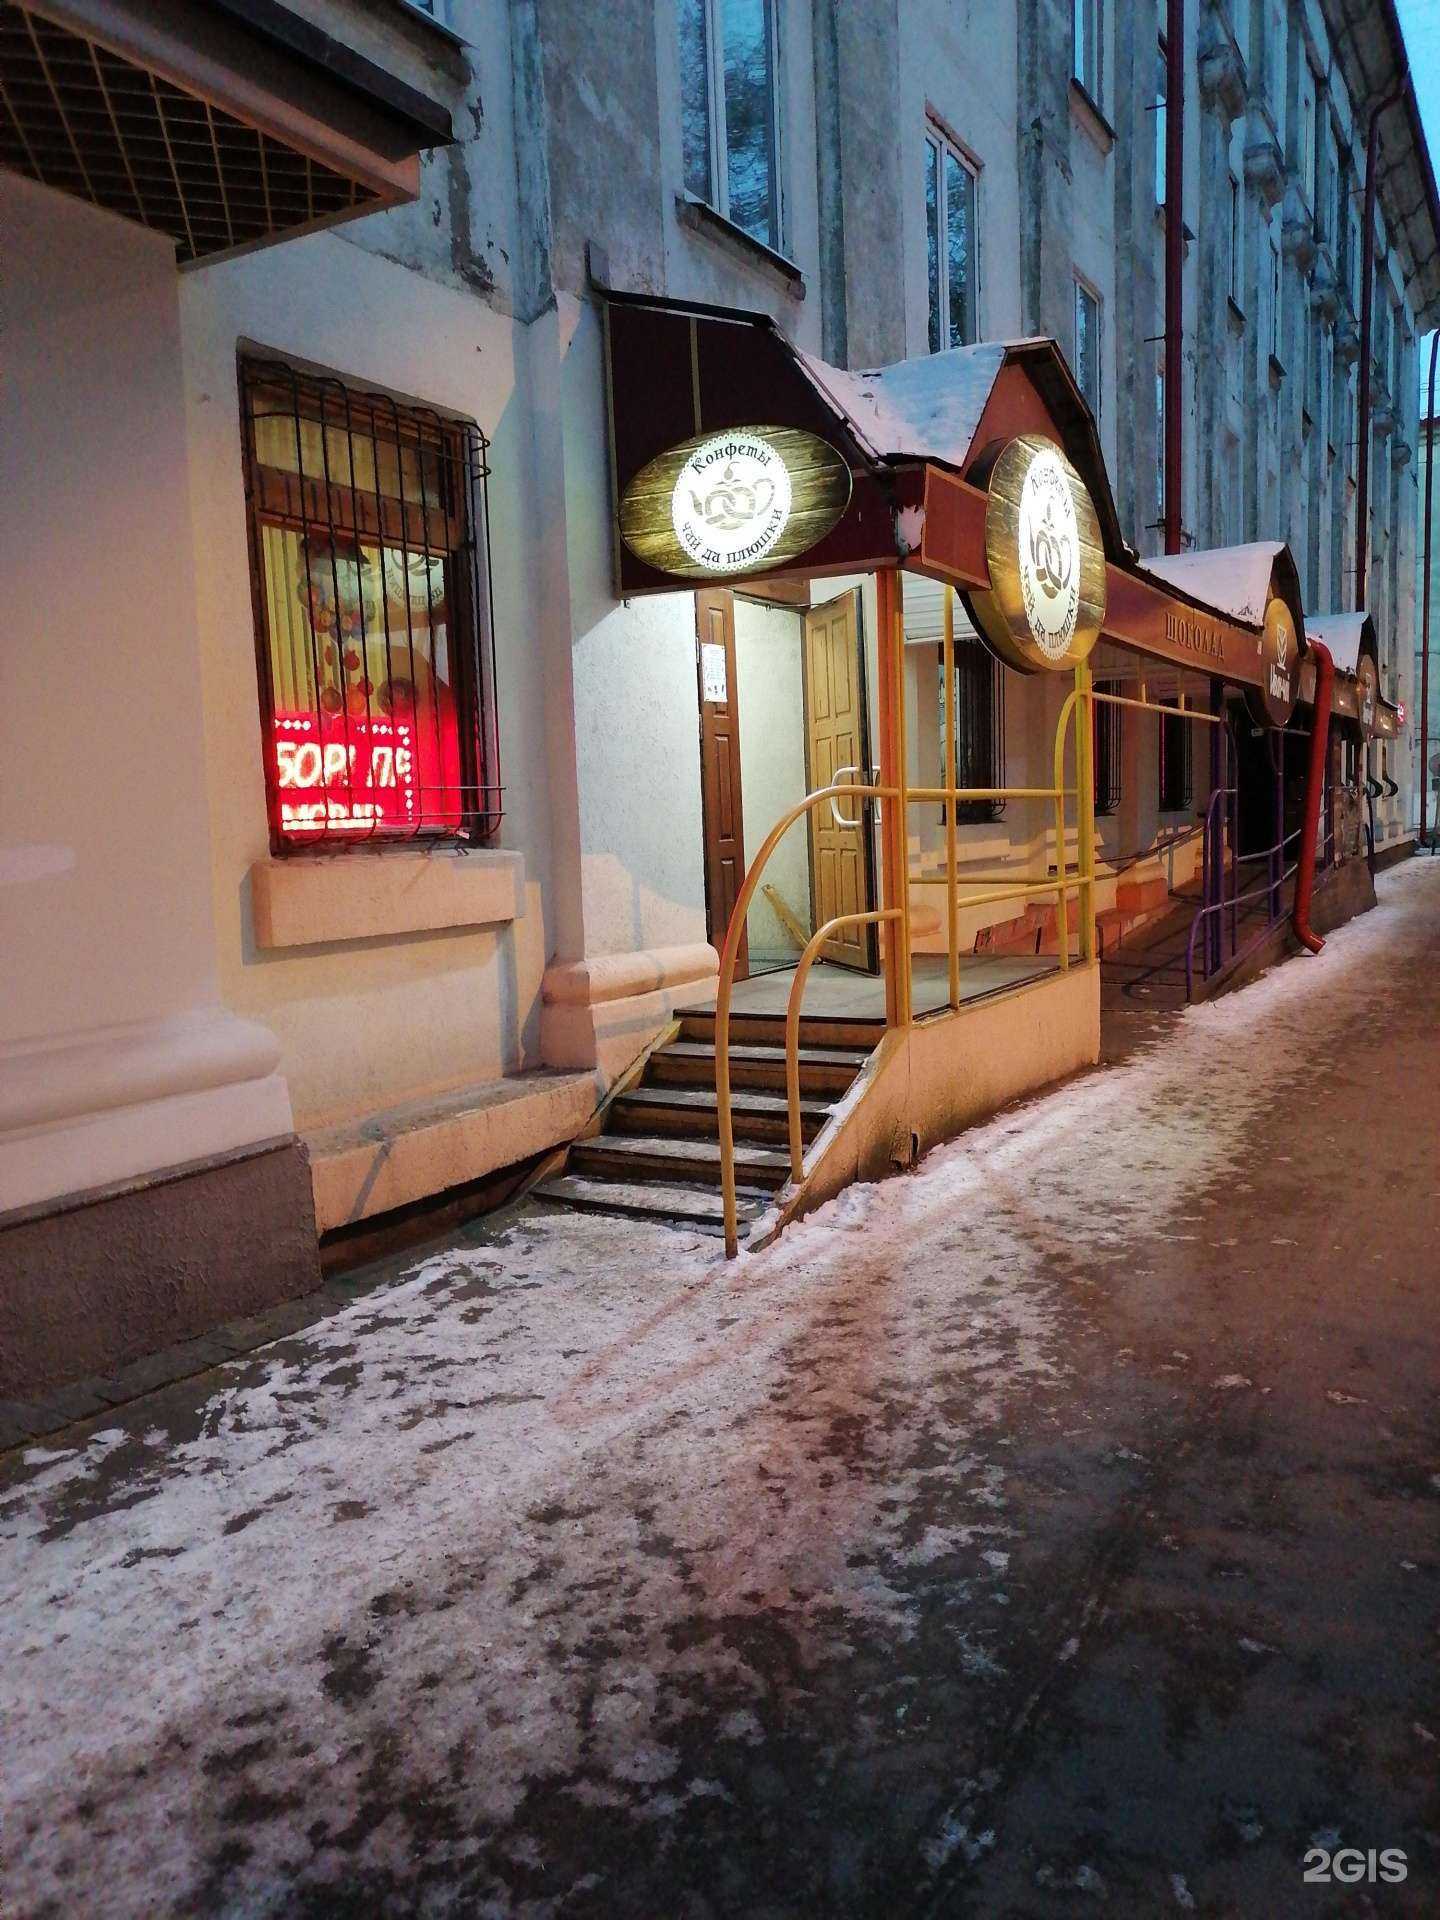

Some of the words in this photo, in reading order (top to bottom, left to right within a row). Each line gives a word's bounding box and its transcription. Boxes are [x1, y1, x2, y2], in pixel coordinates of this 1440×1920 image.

[691, 442, 772, 474] Конфеты
[682, 521, 702, 551] чай
[702, 548, 721, 564] да
[726, 509, 783, 564] плюшки
[1165, 611, 1225, 664] ШОКОЛАД
